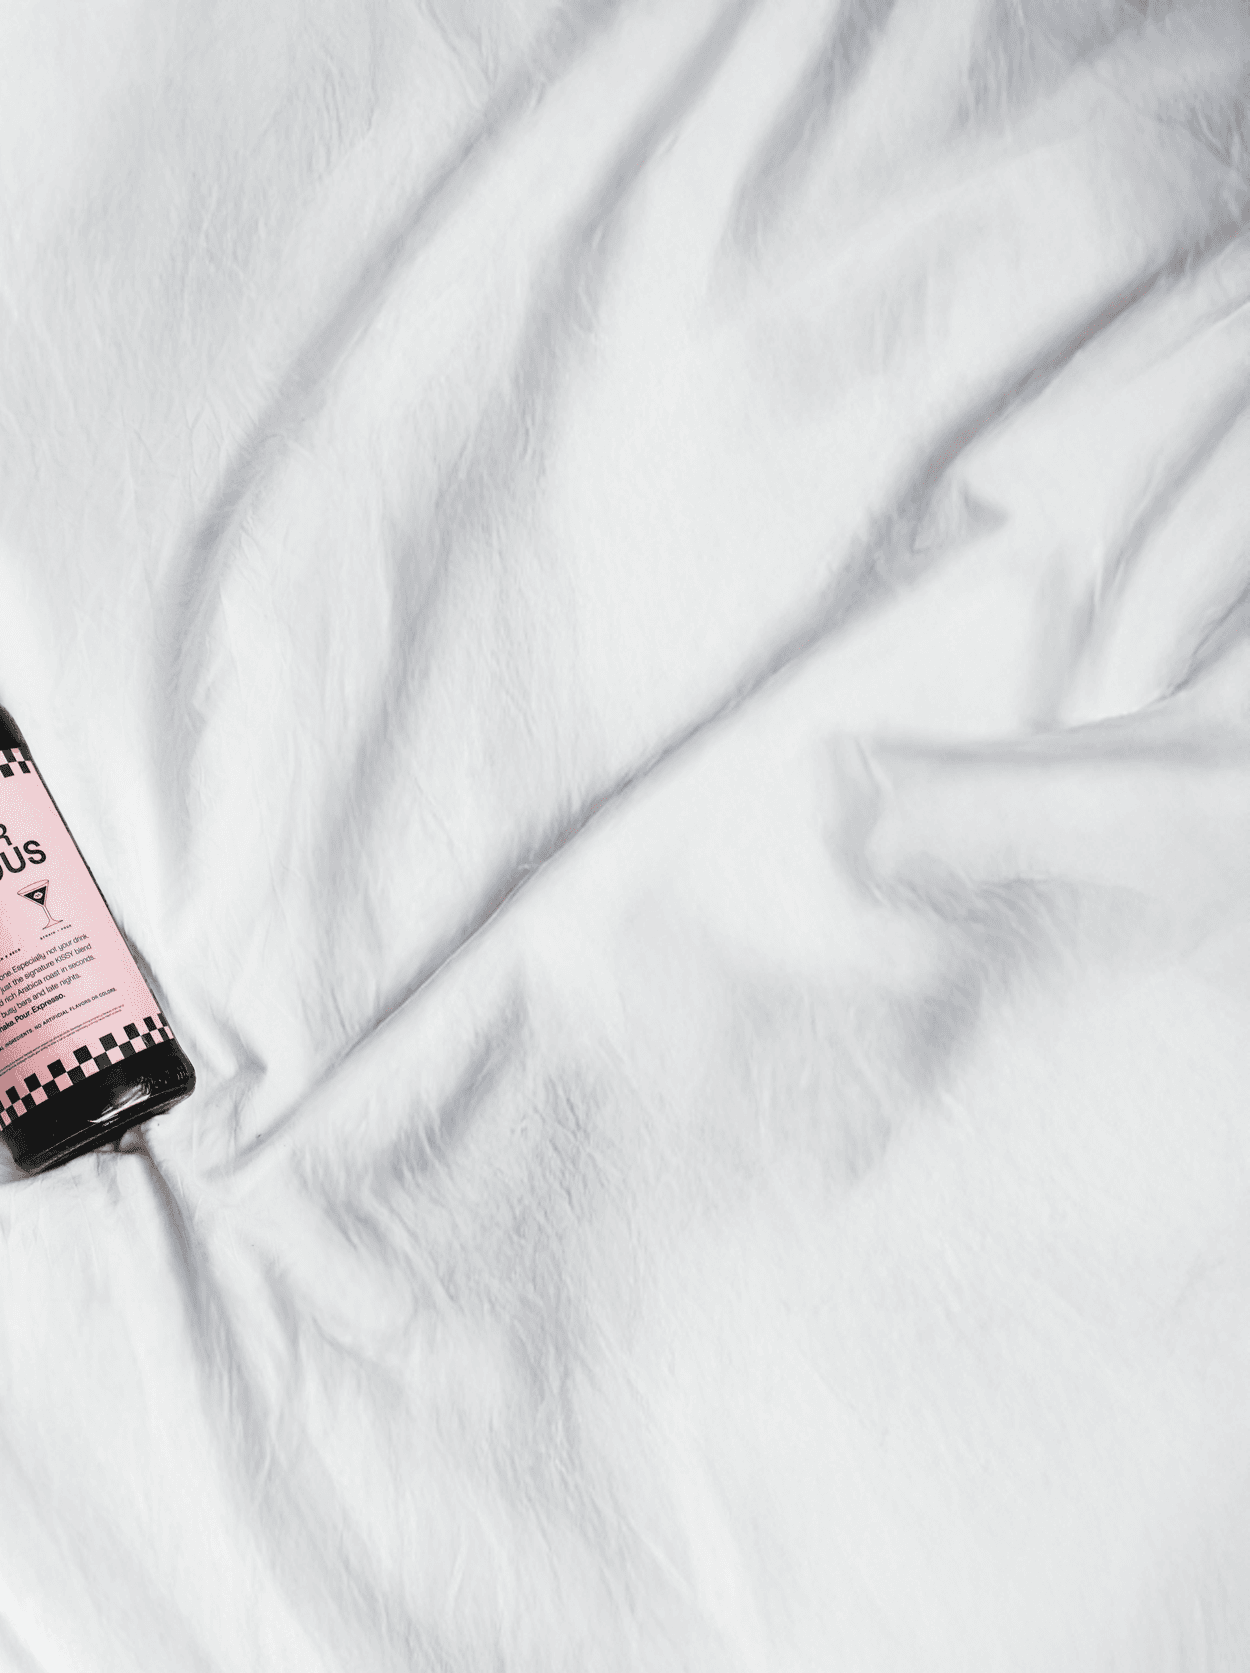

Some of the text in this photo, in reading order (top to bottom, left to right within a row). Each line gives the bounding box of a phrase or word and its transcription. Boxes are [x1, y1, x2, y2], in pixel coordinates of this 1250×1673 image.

[0, 983, 12, 995] just
[12, 976, 24, 985] the
[24, 960, 55, 980] signature
[55, 951, 74, 963] KISSY
[74, 943, 92, 955] blend
[12, 953, 46, 973] Especially
[46, 946, 58, 955] not
[58, 940, 72, 951] your
[1, 1006, 17, 1018] busy
[16, 998, 32, 1009] bars
[32, 989, 46, 1001] and
[46, 983, 59, 993] late
[59, 973, 81, 986] nights.
[4, 992, 18, 1004] rich
[17, 978, 43, 996] Arabica
[42, 969, 60, 982] roast
[68, 955, 96, 970] seconds.
[14, 1011, 33, 1023] Pour.
[31, 993, 66, 1014] Expresso.
[43, 1010, 69, 1025] ARTIFICIAL
[69, 999, 91, 1011] FLAVORS
